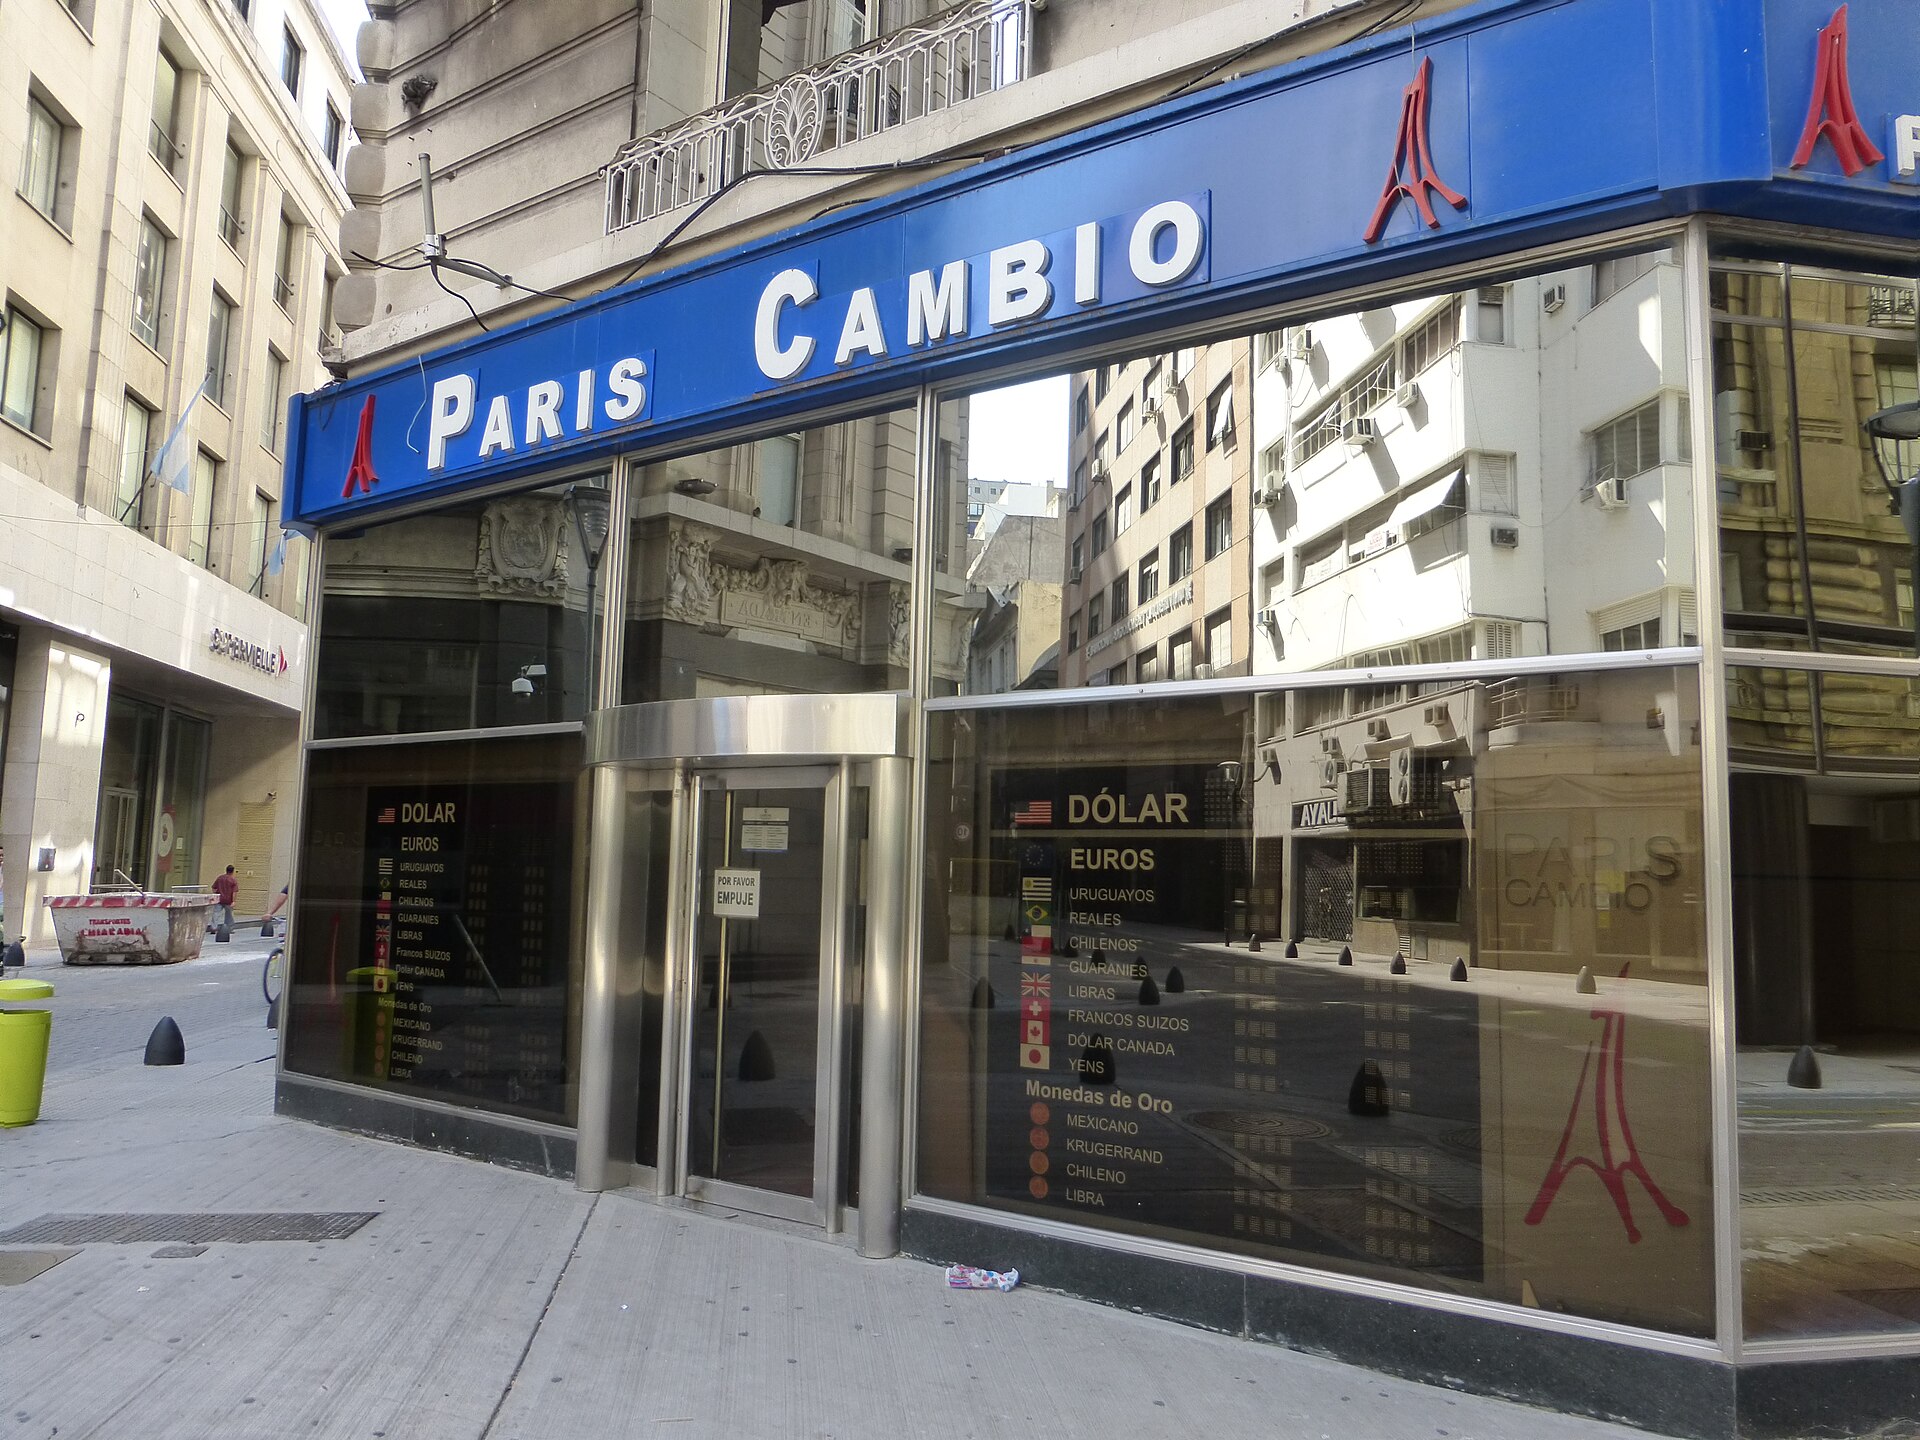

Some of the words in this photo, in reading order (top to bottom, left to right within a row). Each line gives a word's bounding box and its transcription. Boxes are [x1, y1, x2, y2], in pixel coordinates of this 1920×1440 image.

[427, 357, 648, 471] PARIS
[754, 199, 1206, 381] CAMBIO
[1068, 787, 1189, 823] DÓLAR
[401, 803, 456, 823] DOLAR
[401, 837, 439, 852] EUROS
[1070, 848, 1155, 870] EUROS
[1504, 833, 1682, 881] PARIS
[400, 862, 444, 873] URUGUAYOS
[399, 880, 427, 889] REALES
[718, 876, 731, 885] POR
[733, 877, 755, 886] FAVOR
[399, 896, 434, 907] CHILENOS
[717, 891, 753, 906] EMPUJE
[1069, 888, 1155, 902] URUGUAYOS
[398, 913, 439, 925] GUARANIES
[1069, 912, 1121, 926] REALES
[397, 930, 422, 941] LIBRAS
[1069, 936, 1138, 952] CHILENOS
[396, 947, 423, 959] Francos
[424, 949, 451, 961] SUIZOS
[415, 967, 446, 979] CANADA
[1069, 961, 1148, 977] GUARANIES
[1068, 985, 1115, 1000] LIBRAS
[378, 997, 408, 1011] Monedas
[409, 1002, 417, 1011] de
[419, 1002, 432, 1013] Oro
[394, 1017, 431, 1032] MEXICANO
[1068, 1009, 1133, 1027] FRANCOS
[1137, 1015, 1189, 1031] SUIZOS
[1117, 1038, 1175, 1056] CANADA
[392, 1051, 423, 1064] CHILENO
[391, 1067, 412, 1079] LIBRA
[1068, 1058, 1105, 1074] YENS
[1026, 1079, 1104, 1105] Monedas
[1110, 1090, 1132, 1109] de
[1137, 1092, 1173, 1114] Oro
[1067, 1113, 1138, 1135] MEXICANO
[1066, 1139, 1163, 1164] KRUGERRAND
[1066, 1163, 1126, 1184] CHILENO
[1066, 1187, 1104, 1206] LIBRA
